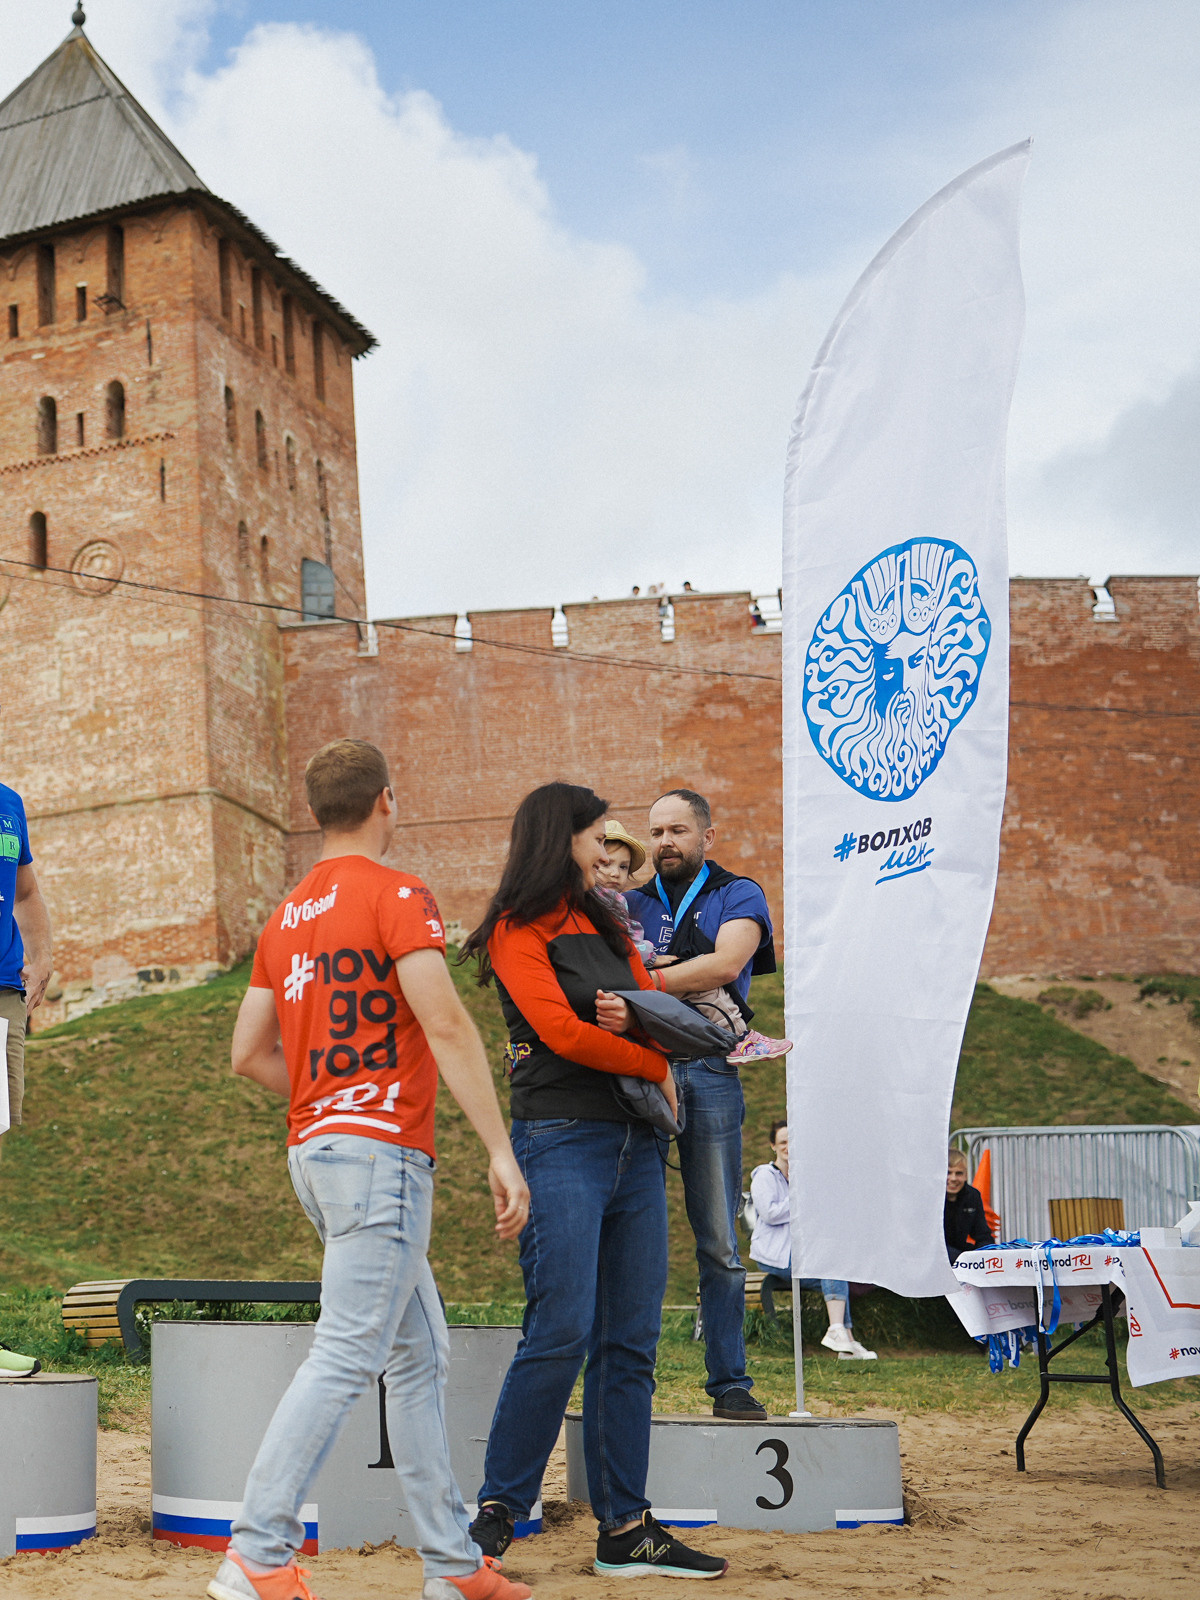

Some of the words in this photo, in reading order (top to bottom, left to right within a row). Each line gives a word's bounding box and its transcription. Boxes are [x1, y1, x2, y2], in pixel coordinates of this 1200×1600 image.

[283, 948, 395, 1004] #nov
[329, 989, 398, 1040] go
[309, 1023, 398, 1082] rod
[755, 1438, 793, 1510] 3
